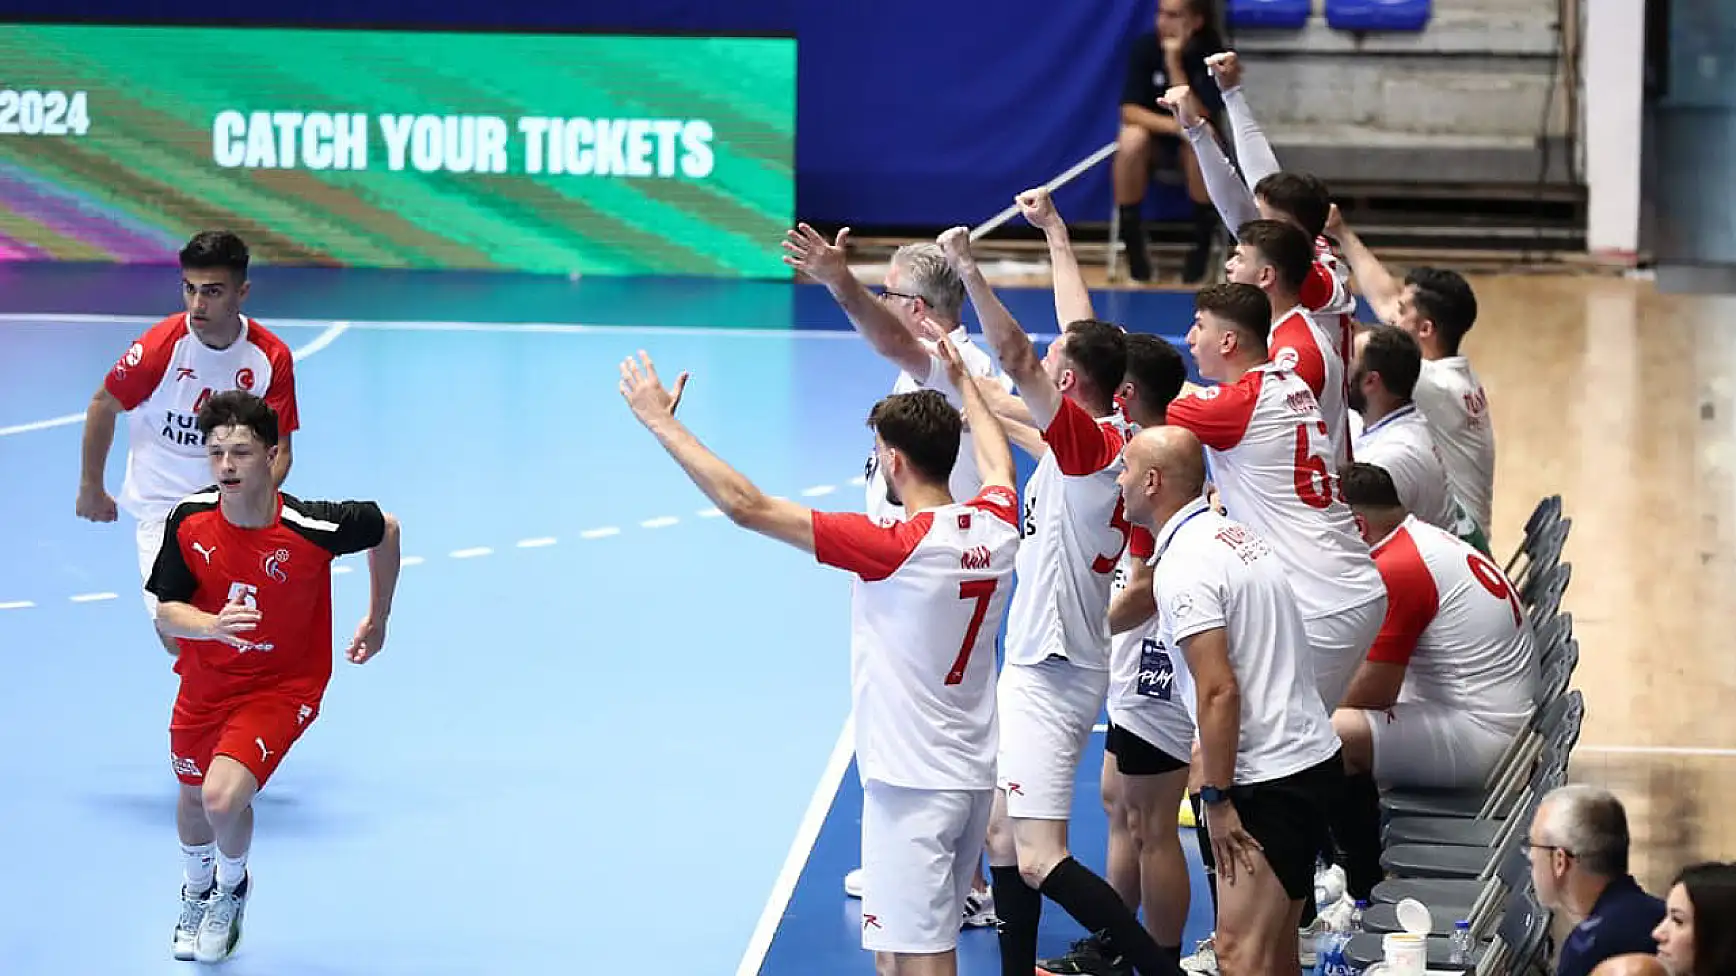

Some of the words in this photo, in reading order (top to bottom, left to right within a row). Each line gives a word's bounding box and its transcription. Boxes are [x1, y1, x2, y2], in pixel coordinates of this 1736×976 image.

[0, 91, 89, 136] 2024
[213, 110, 368, 170] CATCH
[380, 114, 507, 173] YOUR
[518, 116, 715, 178] TICKETS
[944, 577, 998, 686] 7
